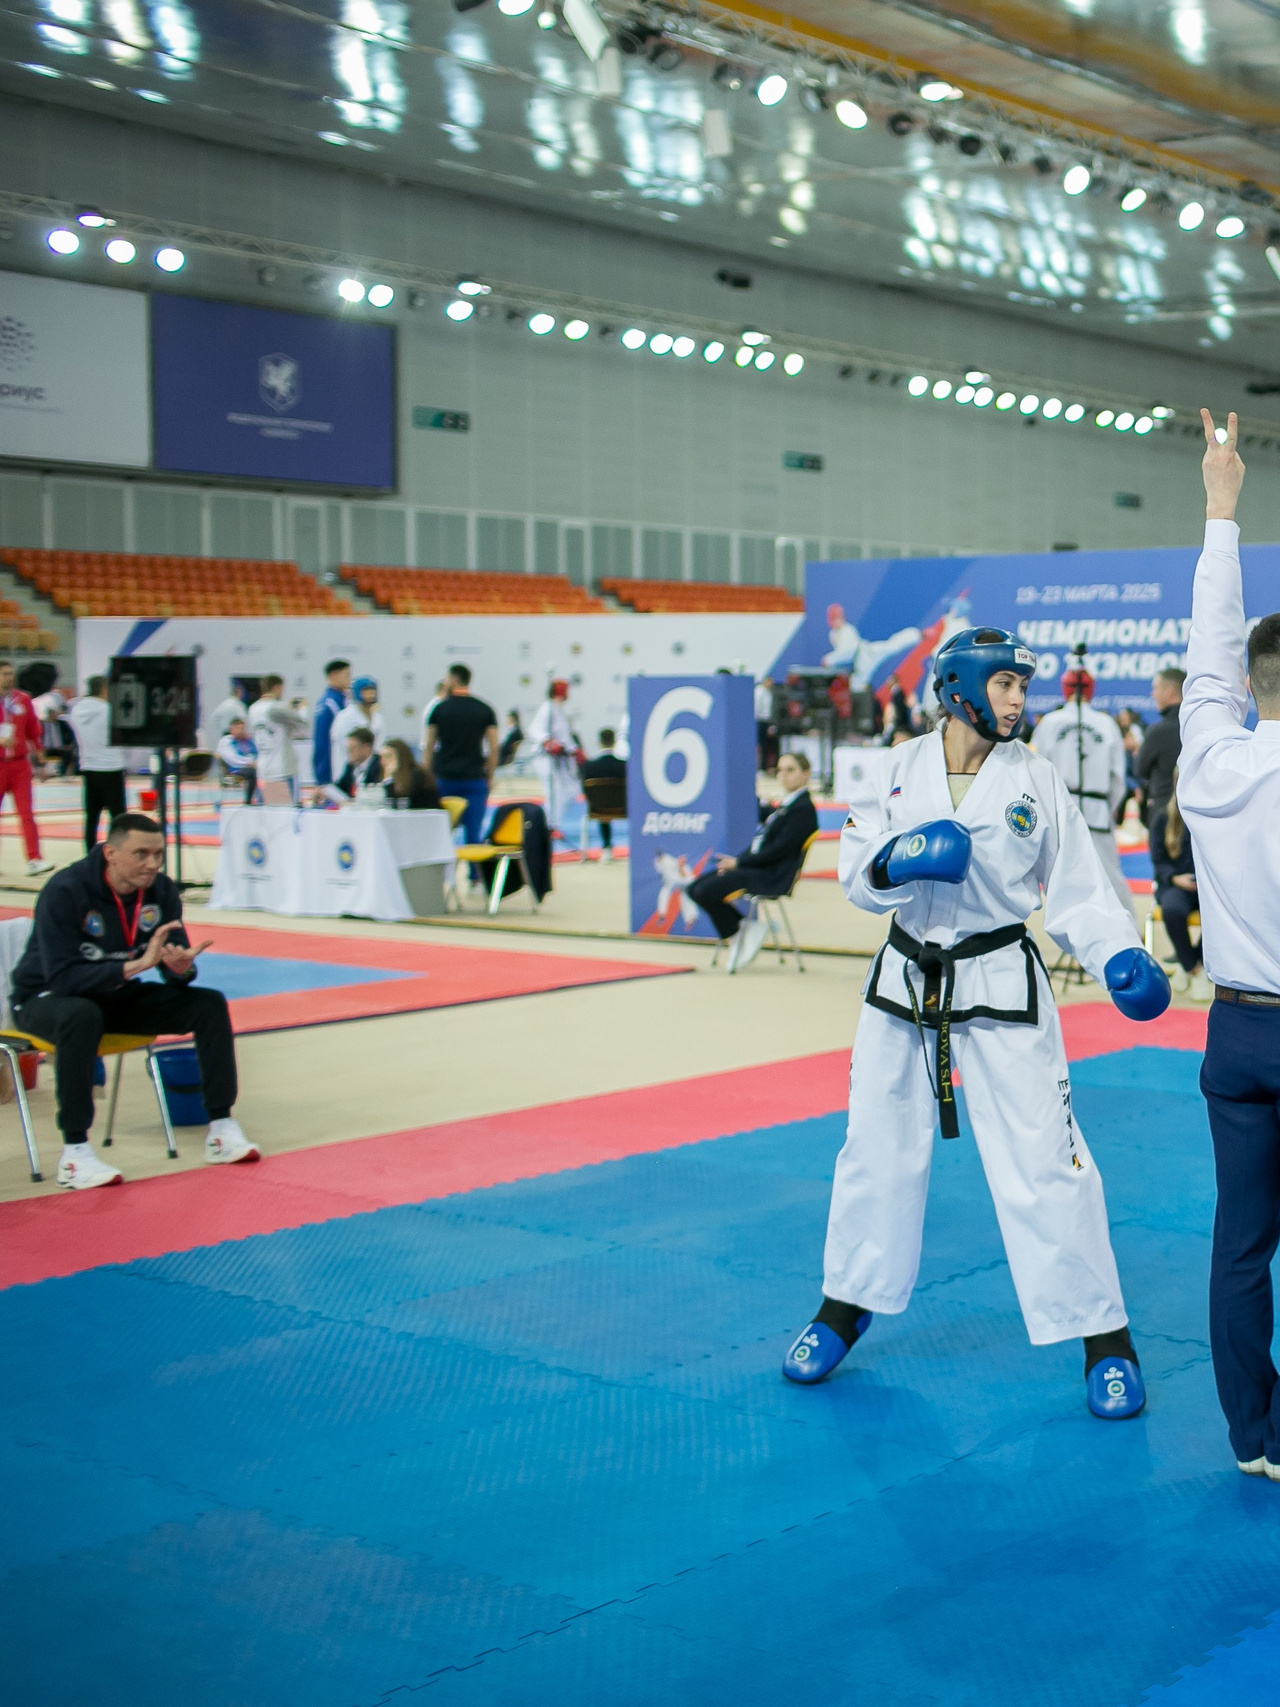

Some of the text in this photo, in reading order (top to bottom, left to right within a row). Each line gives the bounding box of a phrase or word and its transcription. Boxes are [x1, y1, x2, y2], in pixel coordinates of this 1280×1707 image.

[1017, 618, 1193, 647] ЧЕМПИОНАТ
[642, 685, 714, 808] 6
[641, 811, 712, 836] ДОЯНГ
